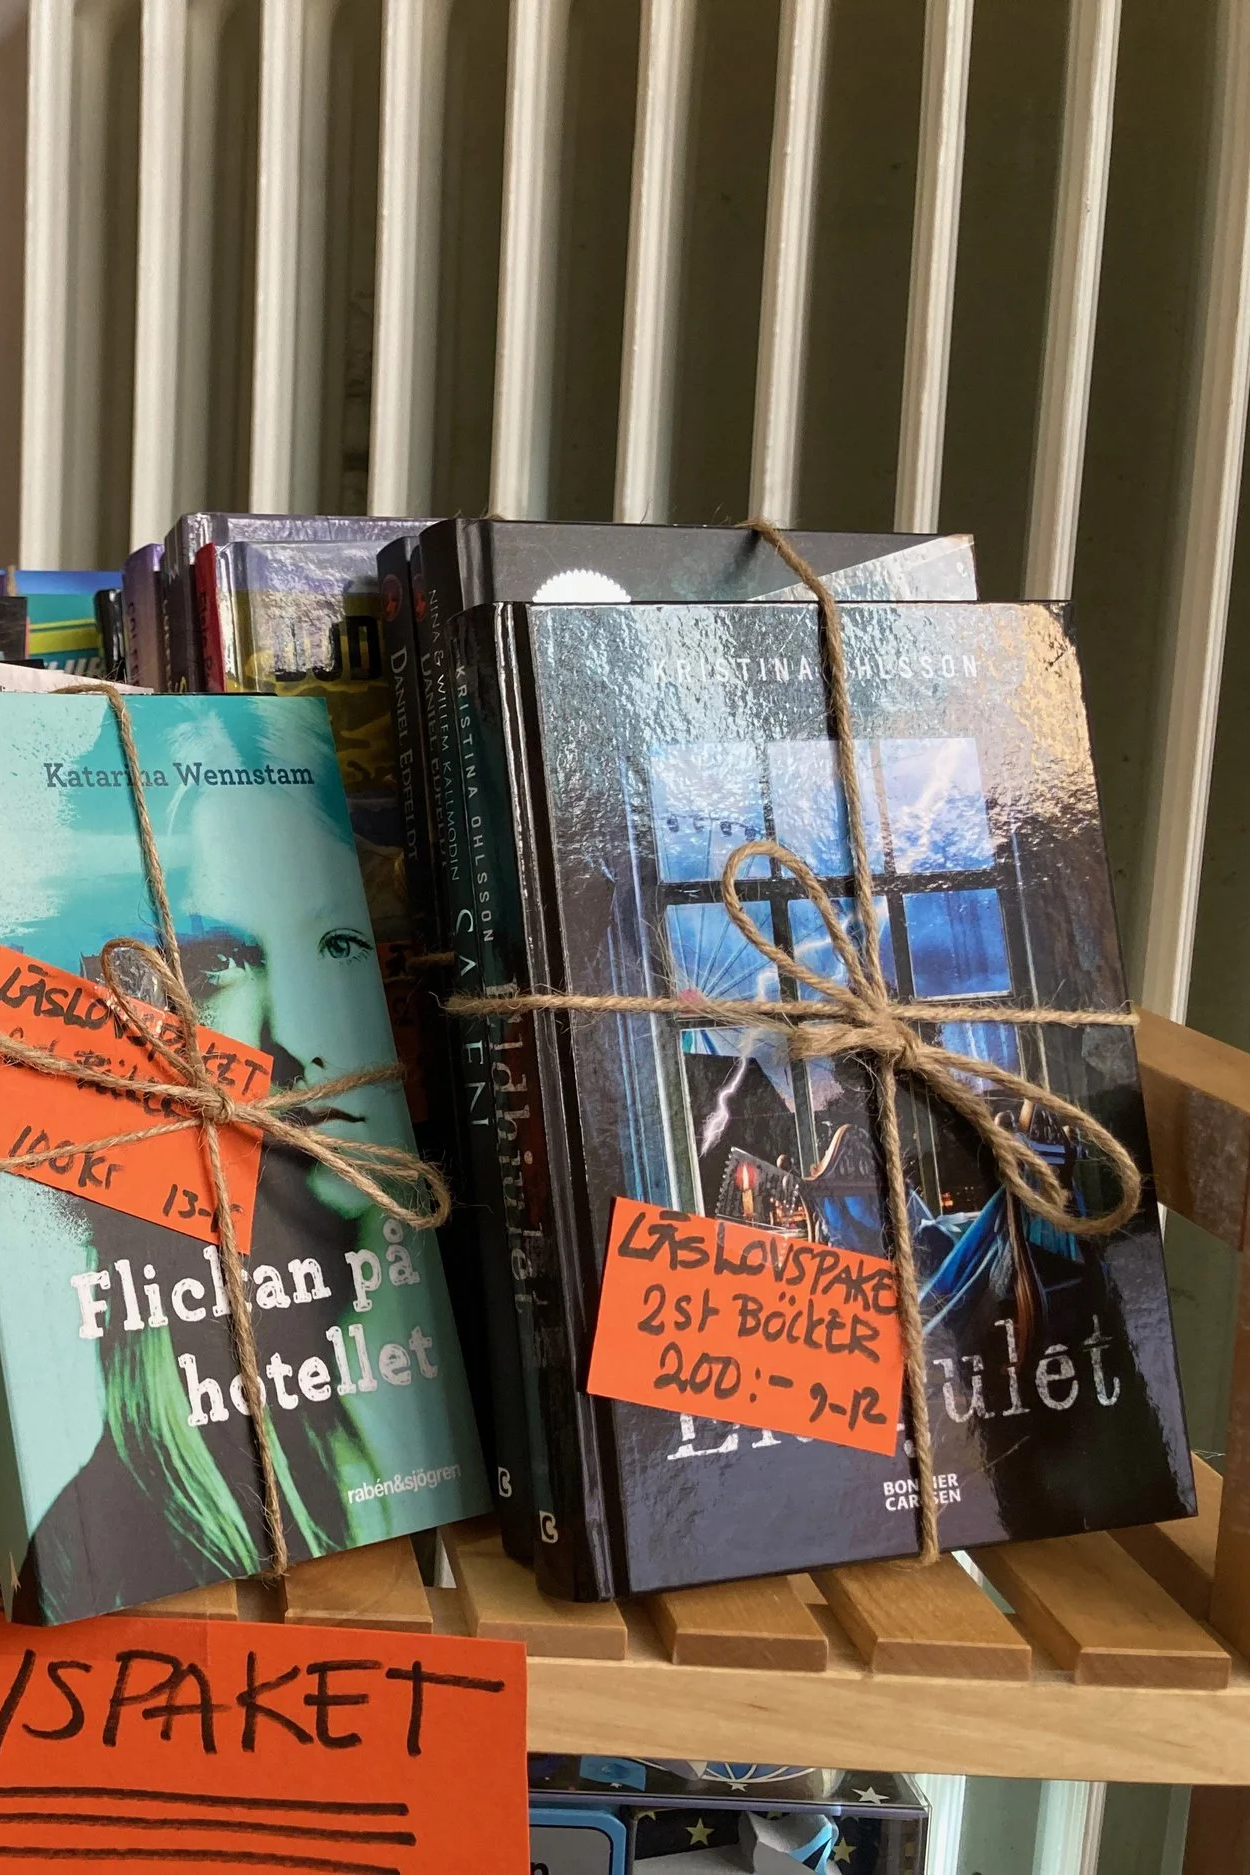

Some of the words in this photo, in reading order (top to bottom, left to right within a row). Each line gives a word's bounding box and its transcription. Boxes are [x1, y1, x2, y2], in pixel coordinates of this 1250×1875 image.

[389, 647, 411, 744] DANIEL
[436, 673, 450, 751] WILLEM
[652, 654, 816, 685] KRISTINA
[822, 653, 980, 682] HLSSON
[173, 762, 316, 787] Wennstam
[399, 749, 418, 862] EDFELDT
[441, 762, 460, 882] KALLMODIN
[454, 664, 479, 800] KRISTINA
[469, 814, 495, 943] OHLSSON
[455, 908, 490, 1127] SAEN
[345, 1217, 422, 1313] på
[177, 1323, 439, 1428] hotellet
[346, 1463, 462, 1505] rabén&sjögren
[882, 1472, 959, 1497] BONIER
[884, 1488, 962, 1512] CARSEN
